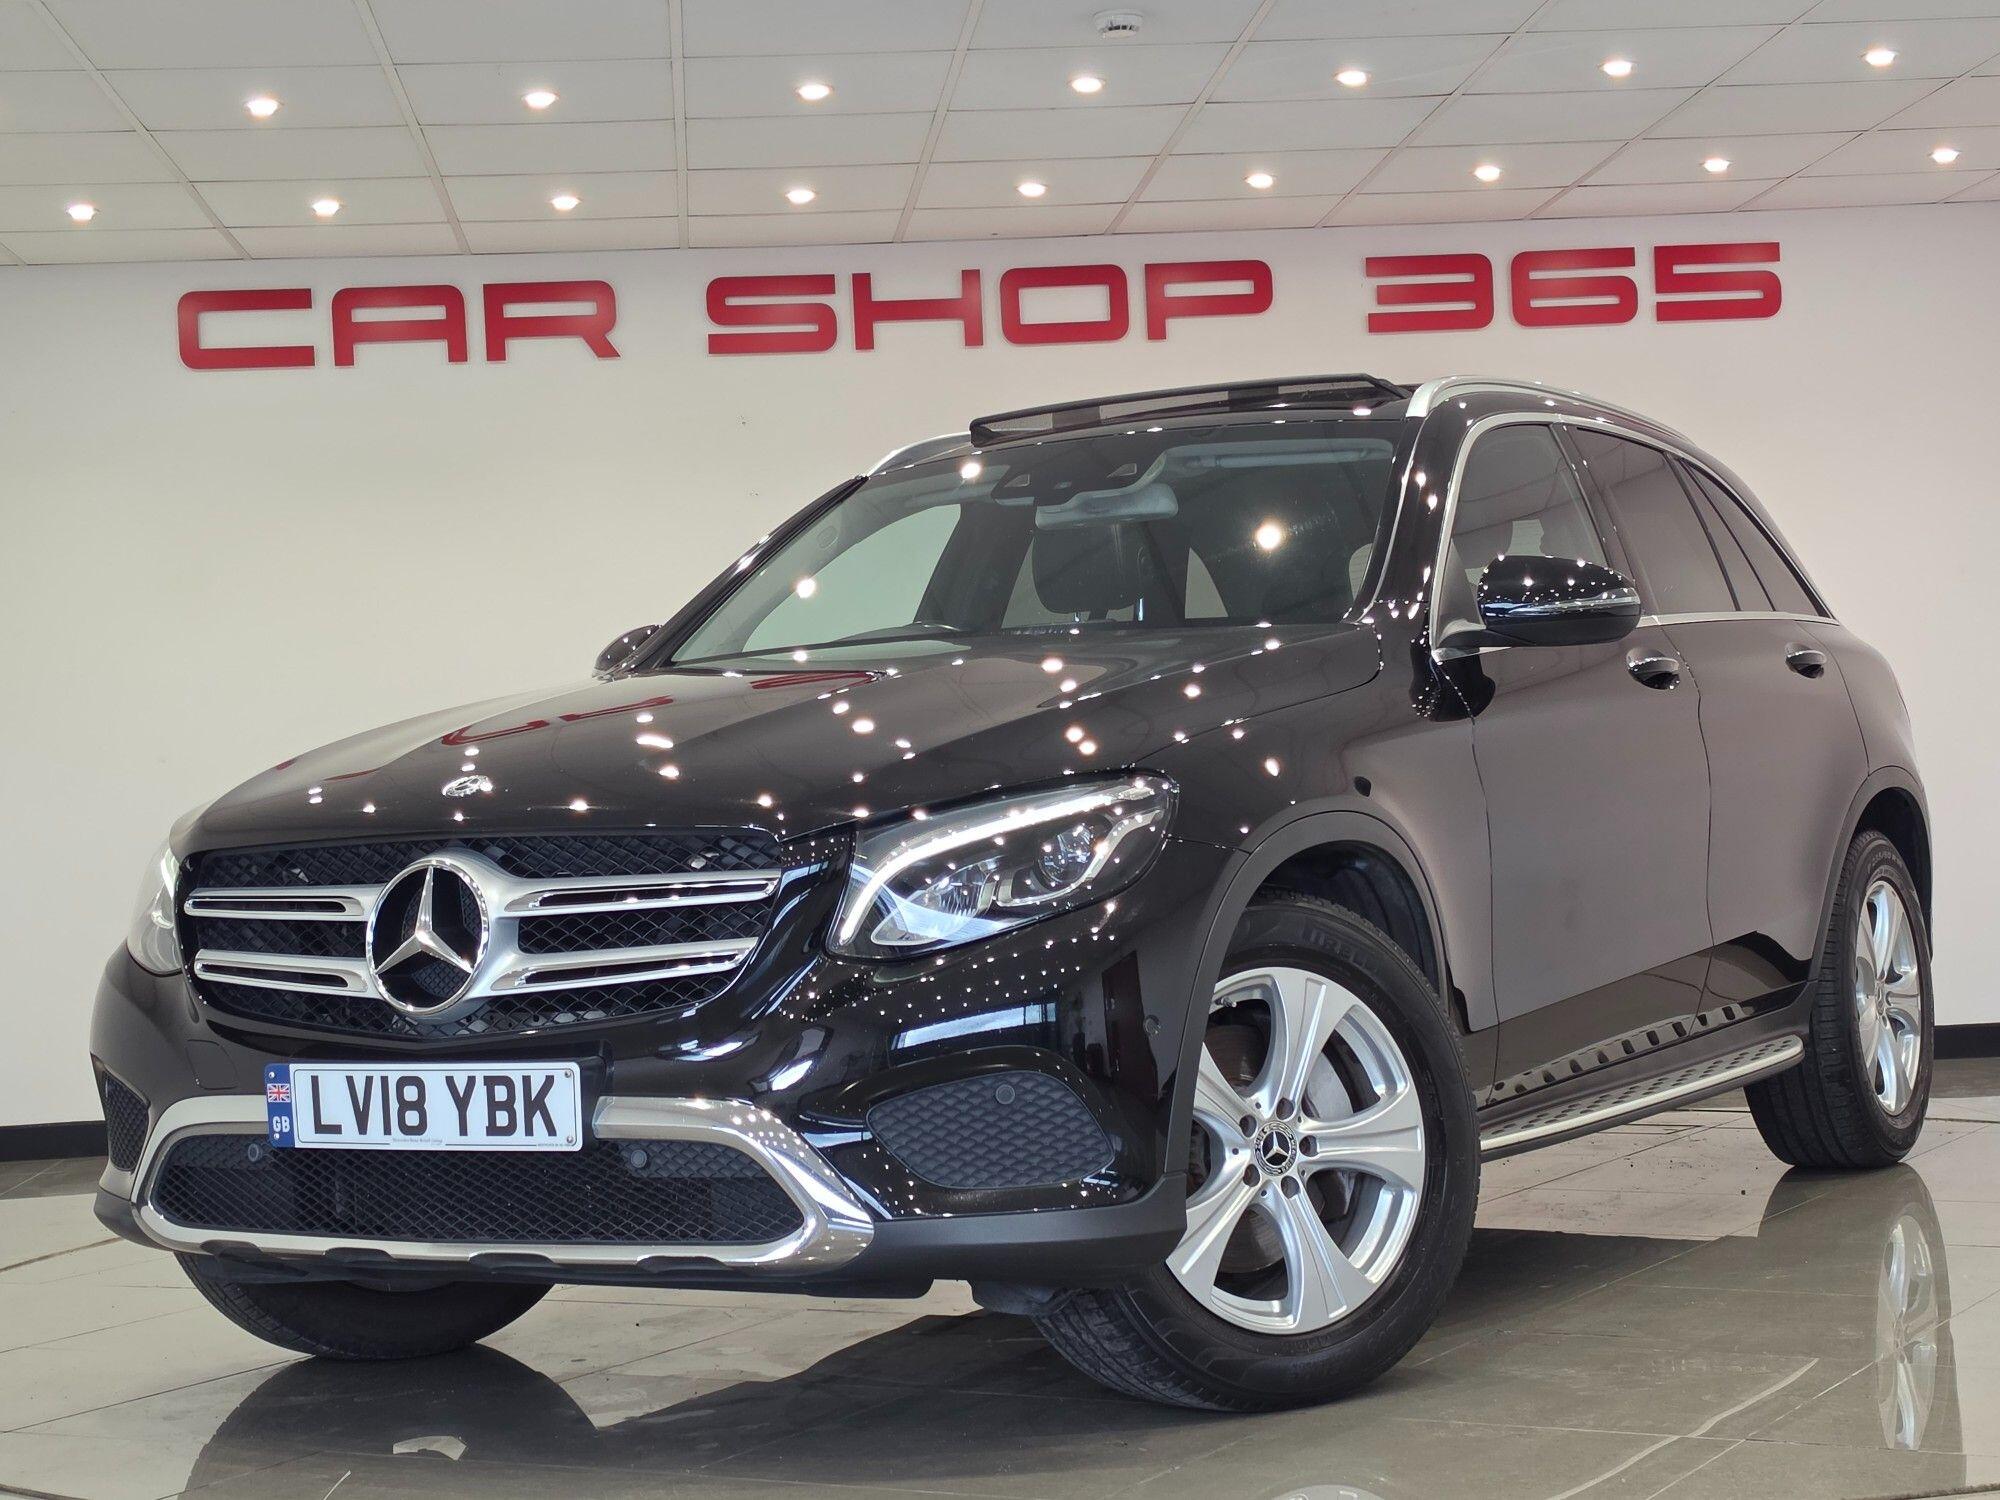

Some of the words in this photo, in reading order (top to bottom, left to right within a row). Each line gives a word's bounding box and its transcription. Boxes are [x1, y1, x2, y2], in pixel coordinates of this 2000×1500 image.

[179, 280, 620, 369] CAR
[706, 260, 1273, 353] SHOP
[1366, 243, 1782, 332] 365
[273, 1116, 290, 1132] GB
[311, 1075, 428, 1136] LV18
[445, 1075, 558, 1137] YBK
